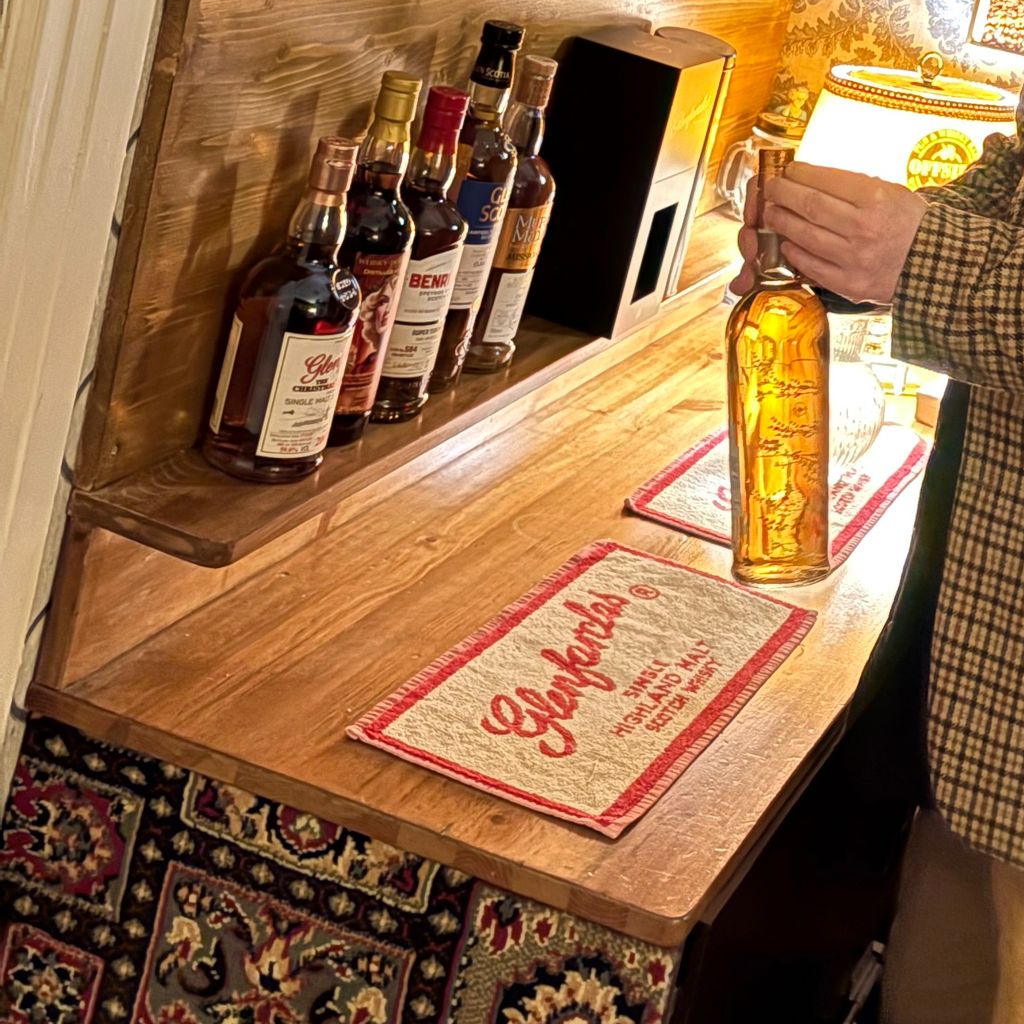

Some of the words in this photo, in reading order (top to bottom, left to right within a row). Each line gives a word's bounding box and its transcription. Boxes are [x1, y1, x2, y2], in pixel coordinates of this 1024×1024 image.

[485, 66, 510, 80] SCOTIA
[284, 397, 314, 406] SINGLE
[611, 671, 683, 739] HIGHLAND
[677, 639, 717, 673] MALT
[643, 694, 690, 734] SCOTCH
